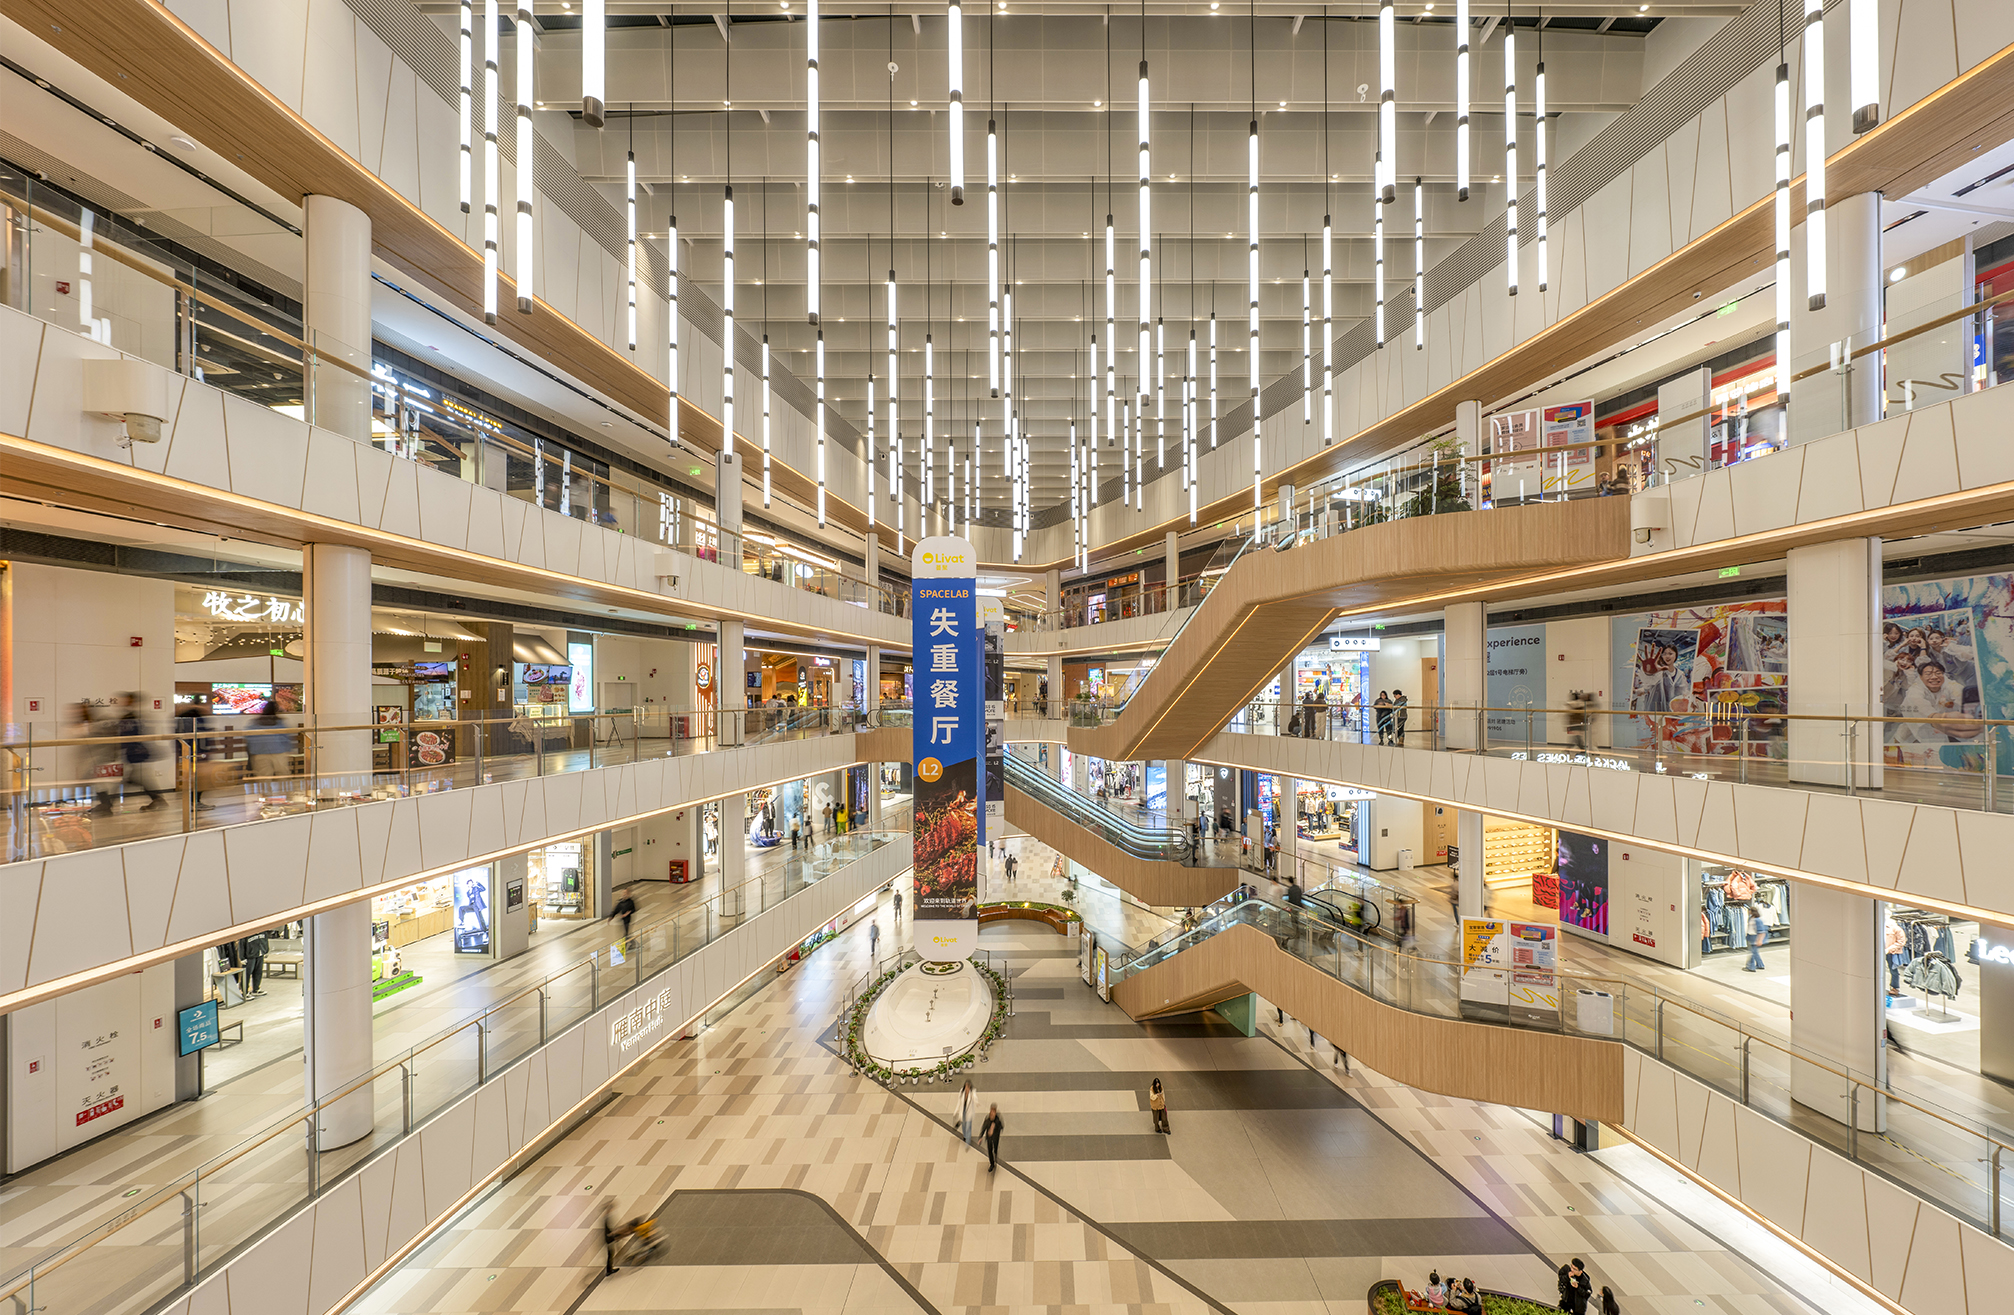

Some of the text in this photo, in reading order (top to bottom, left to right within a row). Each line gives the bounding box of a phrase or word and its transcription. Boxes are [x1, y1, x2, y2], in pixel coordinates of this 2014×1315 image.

[935, 553, 965, 563] Livat
[920, 589, 969, 598] SPACELAB
[1487, 637, 1540, 650] xperience
[929, 607, 960, 745] 失重餐厅
[922, 764, 939, 776] L2
[1468, 944, 1500, 954] 大减价
[1976, 938, 2014, 966] Le
[1485, 954, 1492, 964] 5
[611, 987, 671, 1046] 雁南中庭
[81, 1030, 119, 1050] 消火栓
[188, 1031, 207, 1045] 7.5
[620, 1015, 665, 1052] Yannan Hub
[82, 1084, 119, 1107] 灭火器
